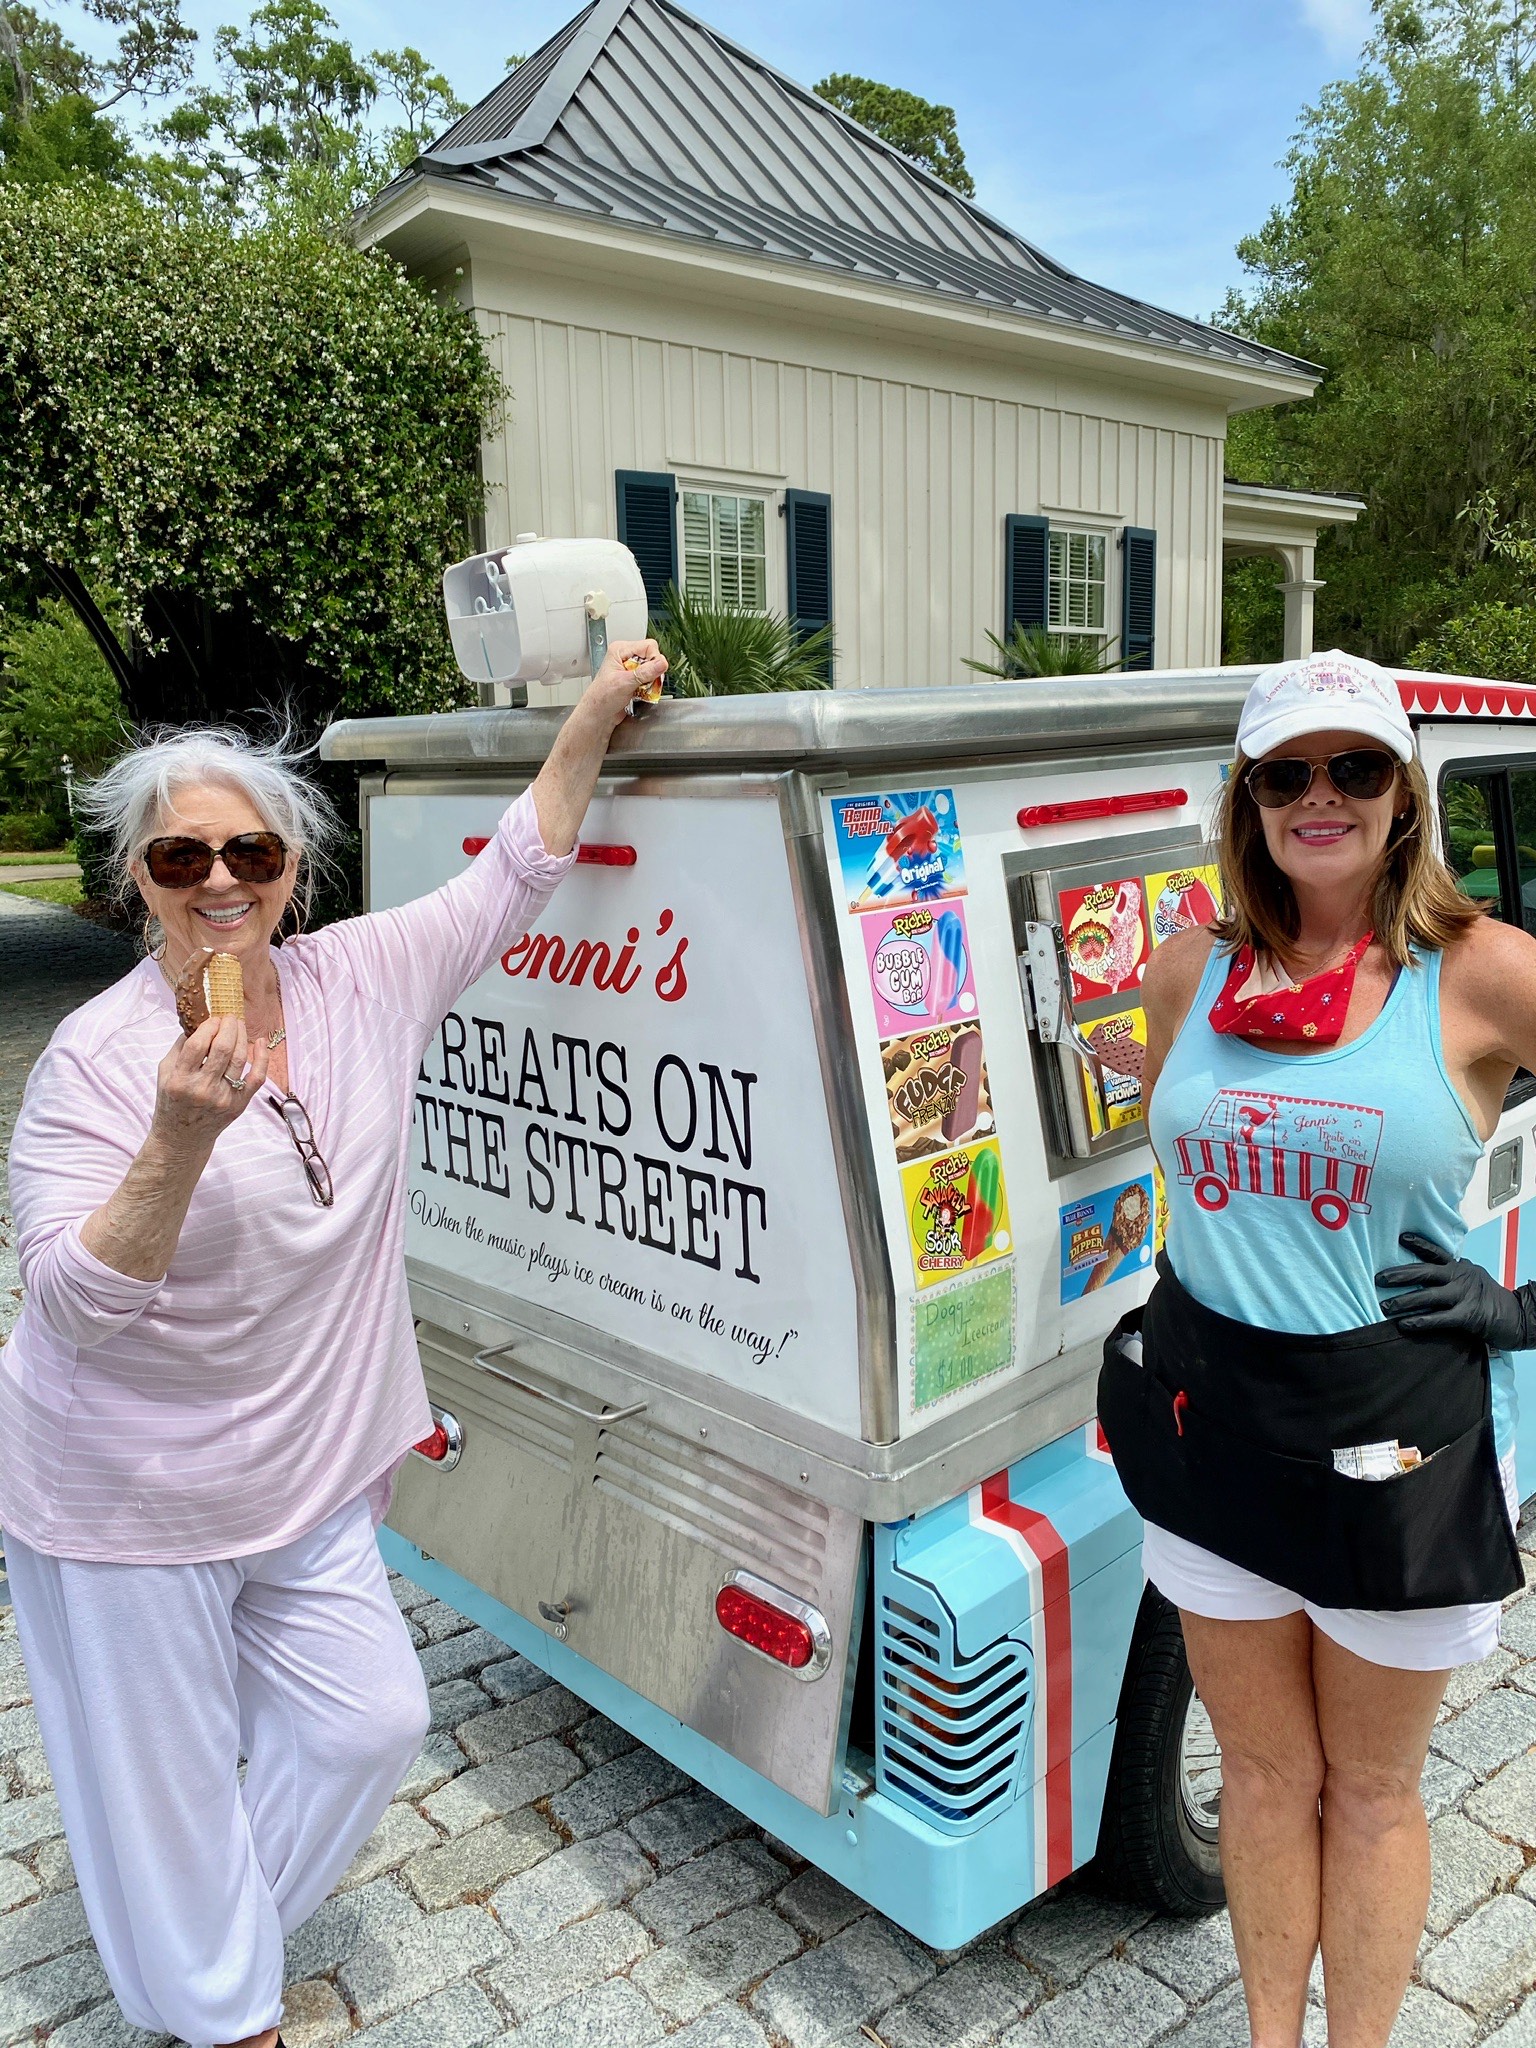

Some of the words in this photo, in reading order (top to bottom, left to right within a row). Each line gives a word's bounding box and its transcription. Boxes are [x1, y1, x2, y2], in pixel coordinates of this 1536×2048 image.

[841, 807, 882, 824] BOMB
[901, 856, 945, 883] Original
[1167, 870, 1196, 896] Rich's
[1083, 886, 1116, 913] Rich's
[893, 909, 932, 939] Rich's
[500, 908, 689, 1002] enni's
[876, 947, 924, 973] BUBBLE
[889, 969, 923, 992] GUM
[902, 988, 923, 1003] BAR
[1101, 1015, 1134, 1043] Rich's
[911, 1030, 951, 1062] Rich's
[418, 1012, 633, 1137] REATS
[654, 1054, 758, 1170] ON
[893, 1061, 967, 1123] FUDGE
[1105, 1080, 1142, 1105] andwich
[912, 1090, 960, 1129] FRENZY
[1294, 1114, 1338, 1132] Jenni's
[1317, 1126, 1345, 1142] Treats
[1324, 1140, 1337, 1153] the
[1341, 1144, 1368, 1160] Street
[931, 1152, 970, 1185] Rich's
[413, 1093, 510, 1198] THE
[525, 1123, 768, 1284] STREET
[1072, 1225, 1101, 1244] BIG
[1070, 1237, 1104, 1260] DIPPER
[918, 1254, 966, 1271] CHERRY
[1075, 1257, 1099, 1271] VANILLA
[465, 1216, 484, 1243] the
[487, 1233, 526, 1259] music
[527, 1242, 570, 1282] plays
[574, 1261, 594, 1285] ice
[599, 1273, 646, 1305] cream
[651, 1290, 665, 1312] is
[671, 1302, 693, 1323] on
[699, 1302, 725, 1336] the
